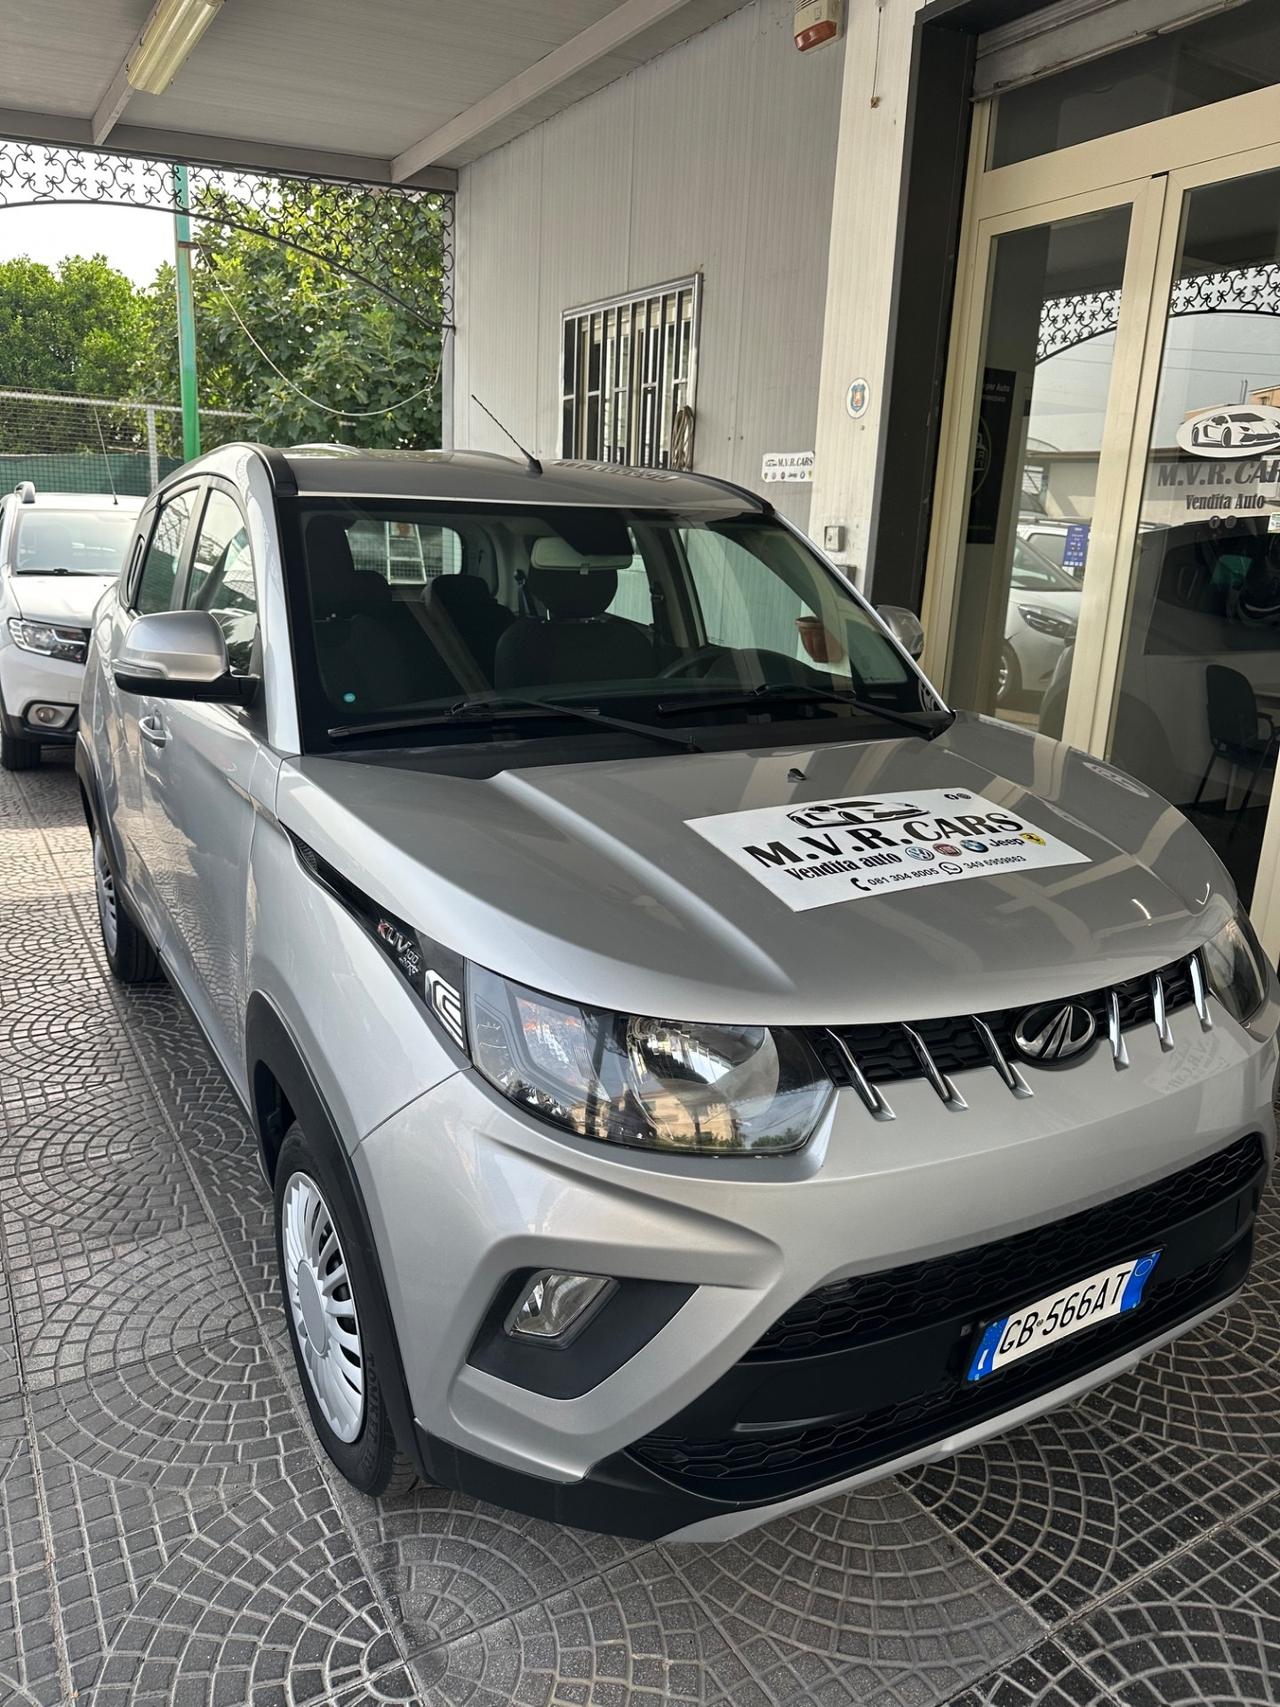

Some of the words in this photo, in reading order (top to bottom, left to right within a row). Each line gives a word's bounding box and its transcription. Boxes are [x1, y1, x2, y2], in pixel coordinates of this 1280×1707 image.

[1185, 493, 1232, 510] Vendita
[1234, 494, 1266, 509] Auto
[742, 812, 1024, 868] M.V.R.CARS
[988, 837, 1026, 848] Jeep
[784, 858, 859, 881] Vendita
[859, 851, 903, 868] auto
[867, 873, 892, 886] 081
[889, 869, 912, 882] 304
[910, 866, 940, 878] 8005
